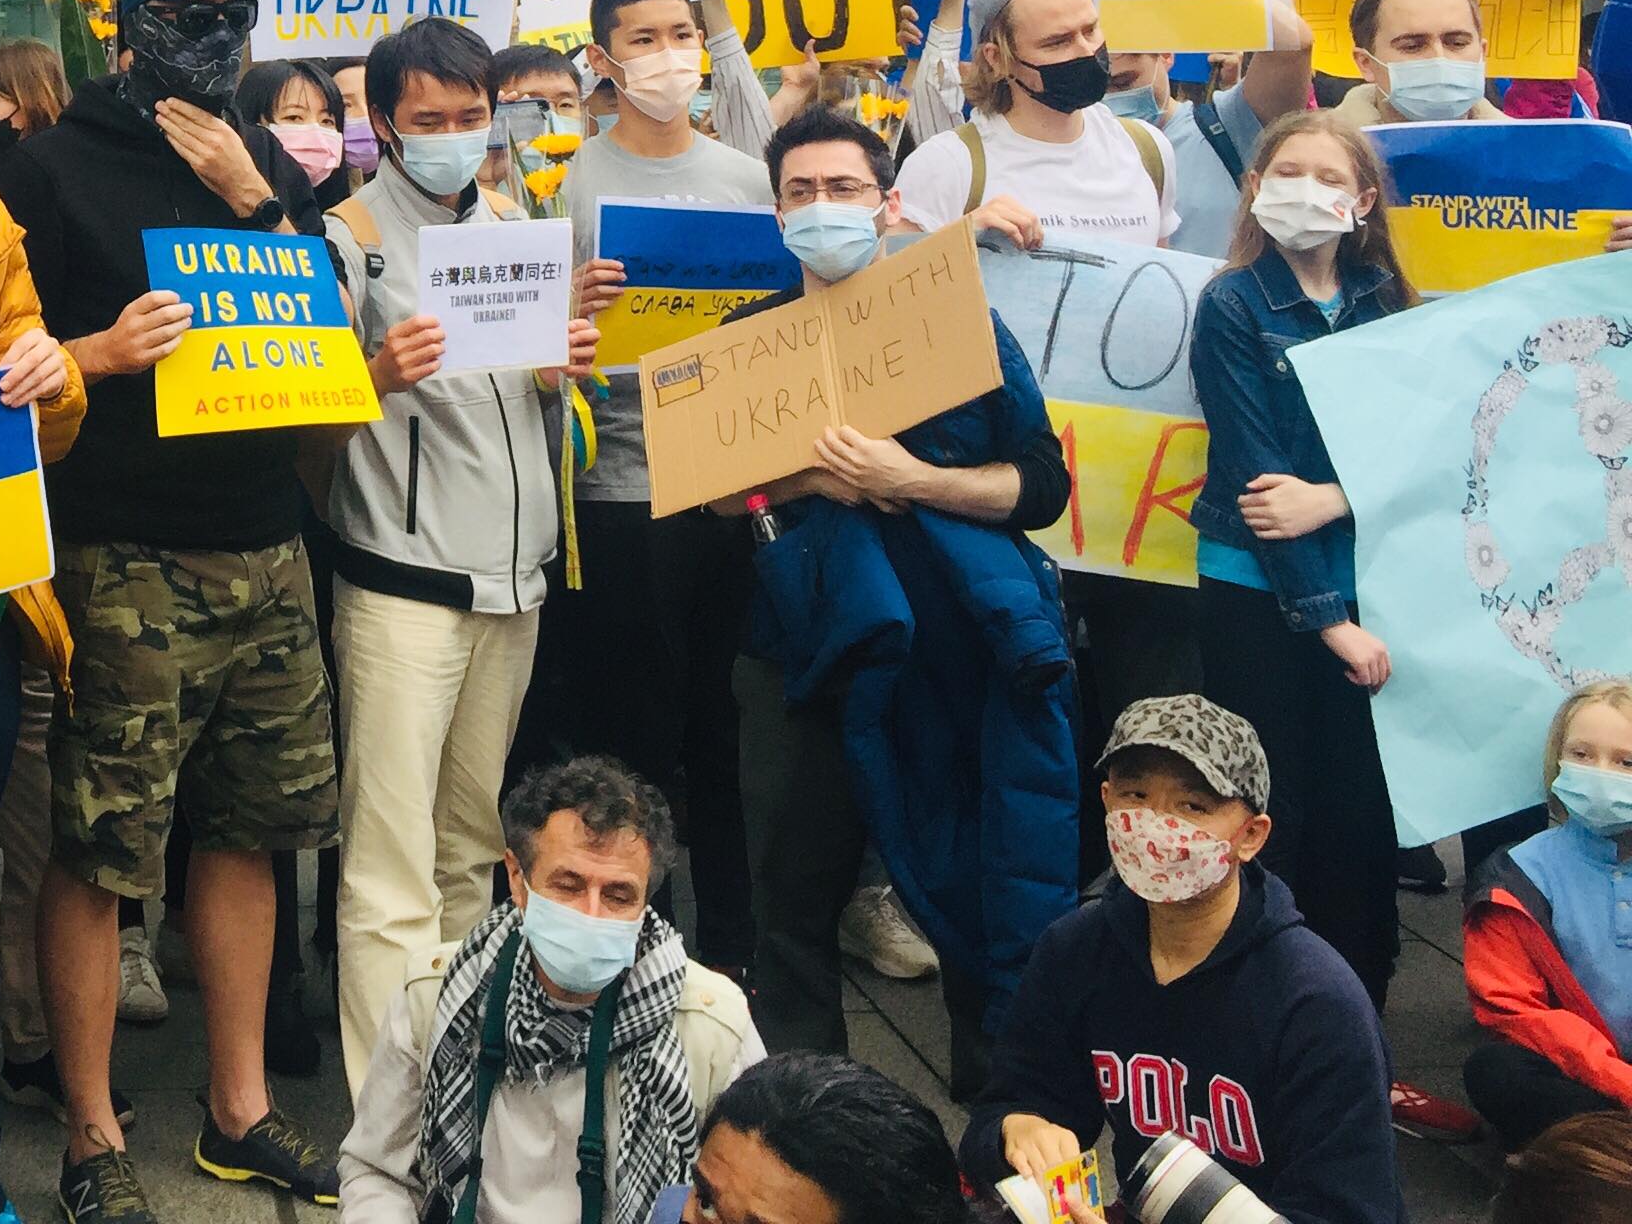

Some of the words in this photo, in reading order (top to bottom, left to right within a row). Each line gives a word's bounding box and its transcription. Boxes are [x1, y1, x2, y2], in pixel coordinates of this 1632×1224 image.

[1410, 194, 1472, 210] STAND
[1477, 195, 1529, 211] WITH
[1070, 214, 1149, 228] Sweetheart
[1441, 208, 1579, 231] UKRAINE
[173, 243, 315, 278] UKRAINE
[450, 294, 485, 308] TAIWAN
[486, 291, 514, 306] STAND
[516, 290, 539, 303] WITH
[844, 251, 955, 326] WITH
[200, 291, 239, 323] IS
[251, 291, 313, 322] NOT
[211, 339, 325, 372] ALONE
[195, 392, 291, 416] ACTION
[300, 387, 367, 407] NEEDED
[1091, 1049, 1264, 1167] POLO
